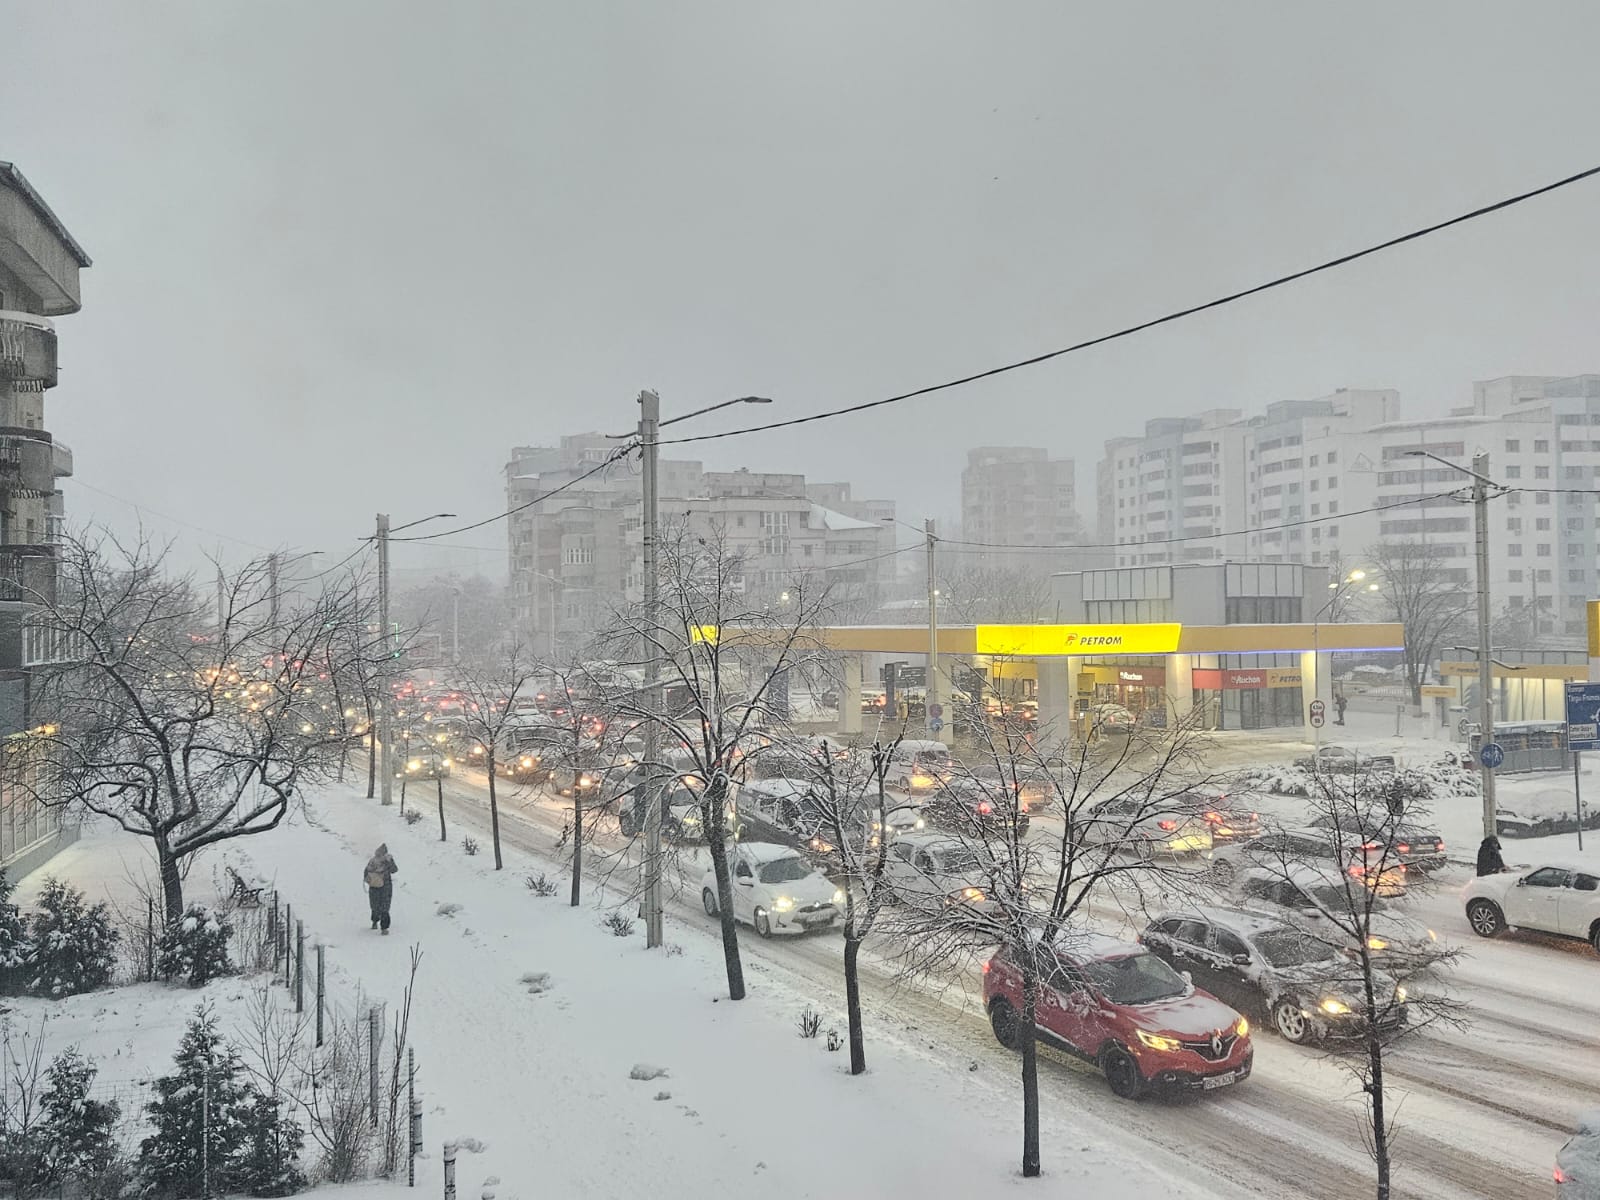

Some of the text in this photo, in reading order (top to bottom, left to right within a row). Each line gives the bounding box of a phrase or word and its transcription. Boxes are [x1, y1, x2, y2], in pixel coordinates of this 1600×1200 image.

[1080, 637, 1122, 646] PETROM
[1236, 674, 1260, 684] Auchan
[1279, 675, 1302, 683] PETRO
